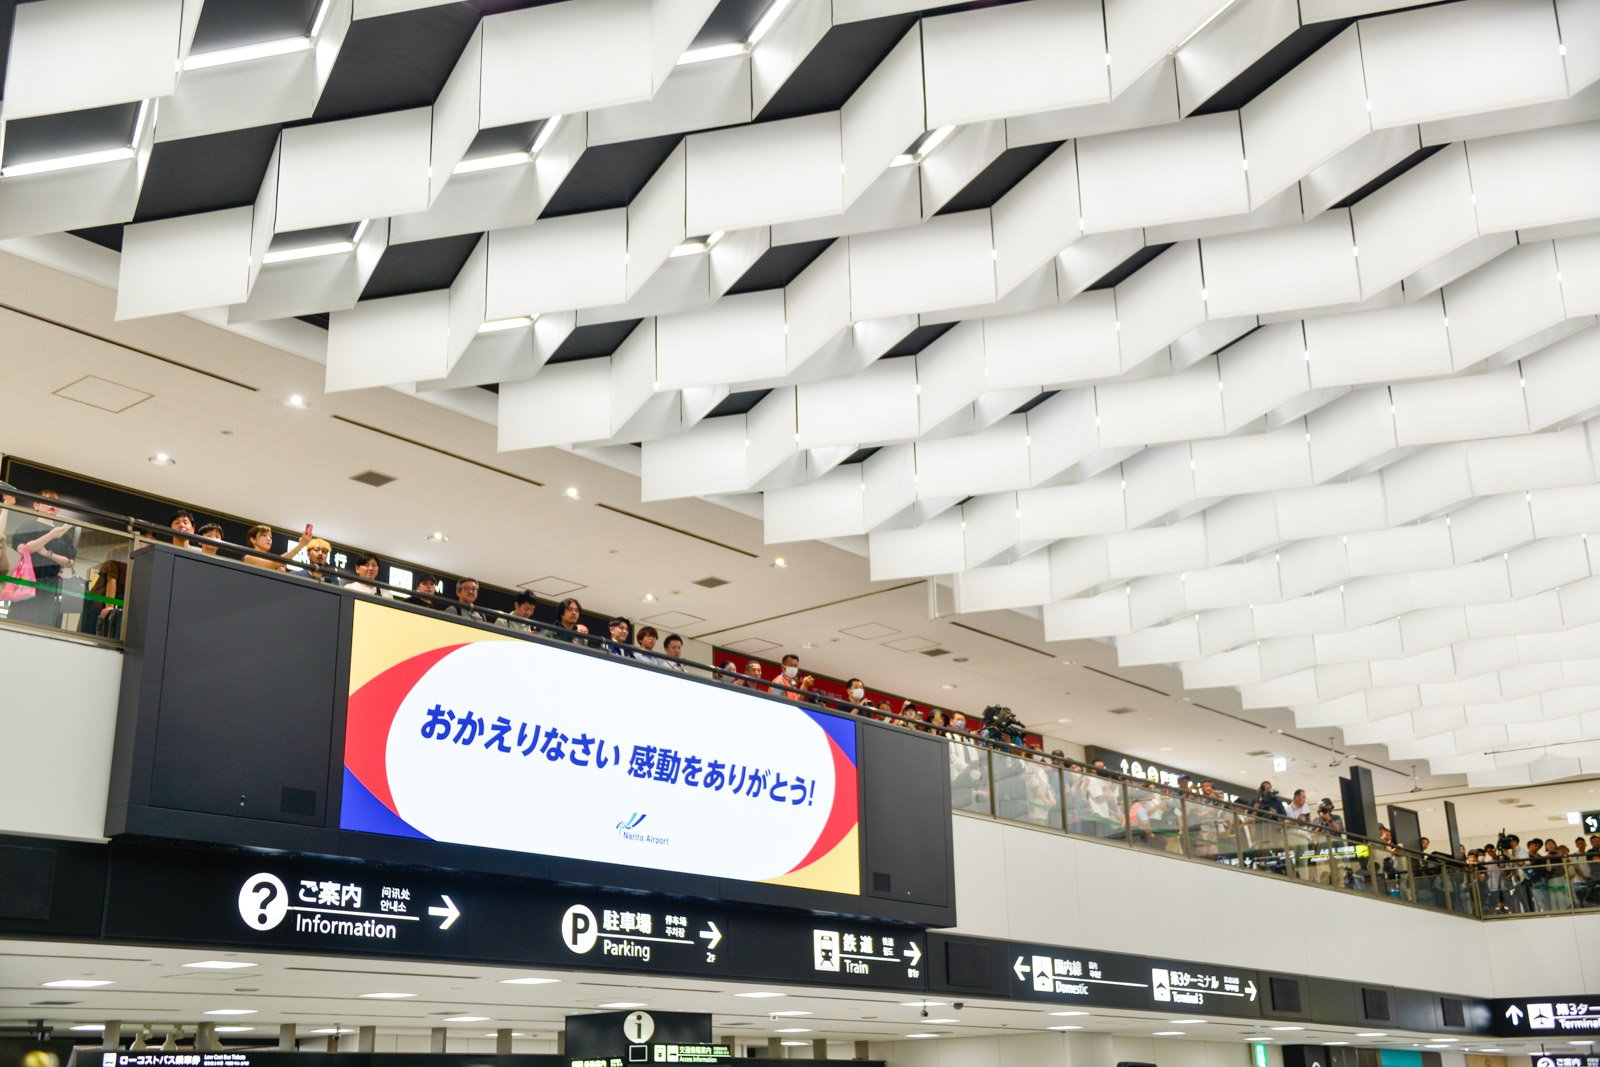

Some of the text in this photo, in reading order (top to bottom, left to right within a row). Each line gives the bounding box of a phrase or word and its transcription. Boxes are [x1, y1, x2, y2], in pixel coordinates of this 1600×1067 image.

[420, 704, 816, 807] おかえりなさい 感動をありがとう!
[623, 831, 669, 845] Narita Airport
[298, 880, 362, 908] ご案内
[381, 886, 411, 900] 问讯处
[380, 900, 407, 913] 안내소
[296, 914, 396, 939] Information
[571, 912, 590, 946] P
[603, 910, 652, 934] 駐車場
[603, 939, 651, 962] Parking
[843, 933, 873, 953] 鉄道
[706, 952, 716, 962] 2F
[844, 959, 868, 974] Train
[1055, 980, 1089, 995] Domestic
[1169, 970, 1220, 989] 第3ターミナル
[1171, 991, 1204, 1005] Terminal 3
